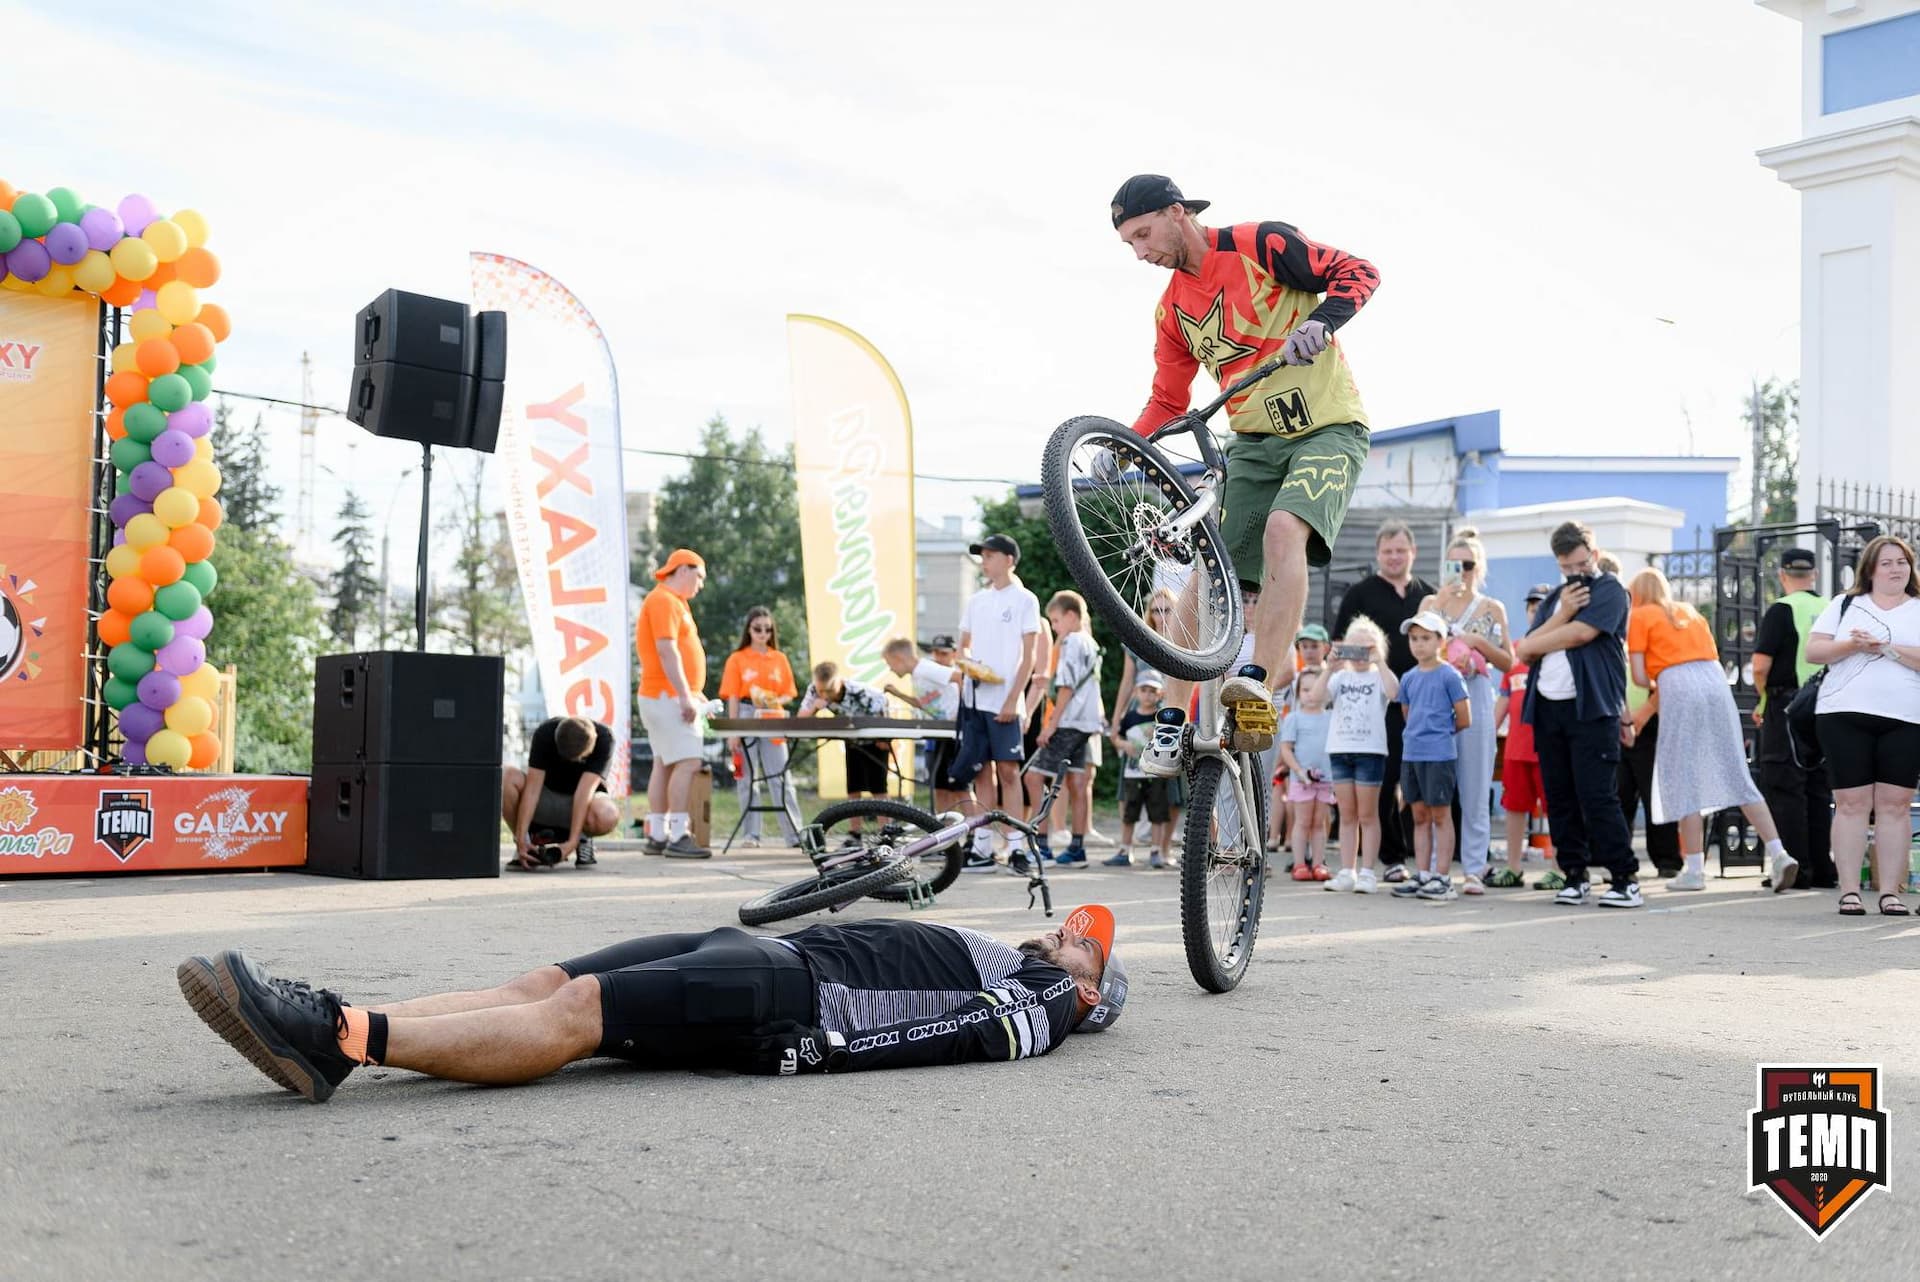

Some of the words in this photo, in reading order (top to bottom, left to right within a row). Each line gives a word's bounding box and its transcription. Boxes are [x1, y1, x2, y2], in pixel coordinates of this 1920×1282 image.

[101, 810, 149, 835] ТЕМП
[174, 811, 288, 834] GALAXY
[1043, 975, 1076, 1001] OKO
[959, 1009, 989, 1025] YO
[994, 994, 1038, 1017] YOKO
[850, 1031, 900, 1052] YOKO
[907, 1021, 958, 1040] YOKO
